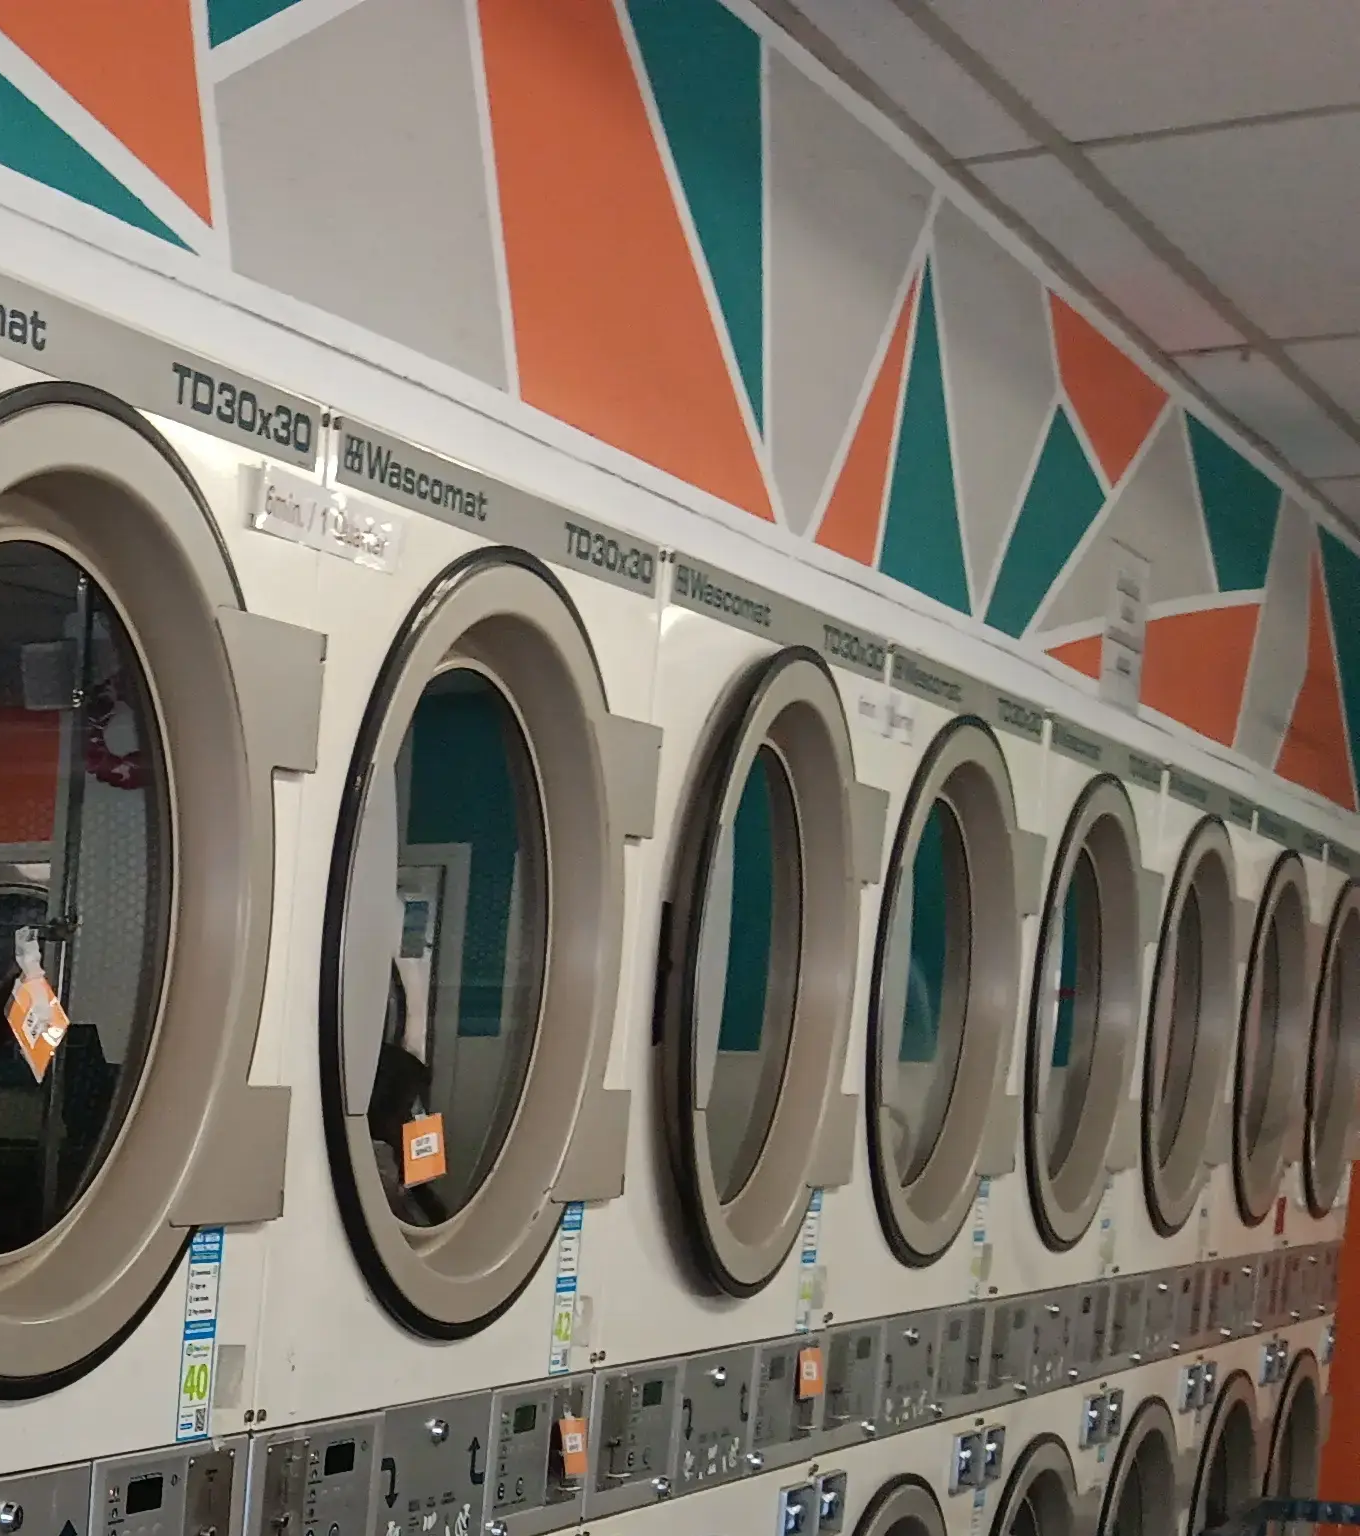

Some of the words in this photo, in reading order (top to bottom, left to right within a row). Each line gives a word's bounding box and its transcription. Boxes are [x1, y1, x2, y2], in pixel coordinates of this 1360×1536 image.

[172, 362, 311, 453] TD30x30
[366, 441, 488, 521] Wascomat
[565, 521, 653, 584] TD30x30
[689, 566, 772, 627] Wascomat
[183, 1364, 209, 1402] 40
